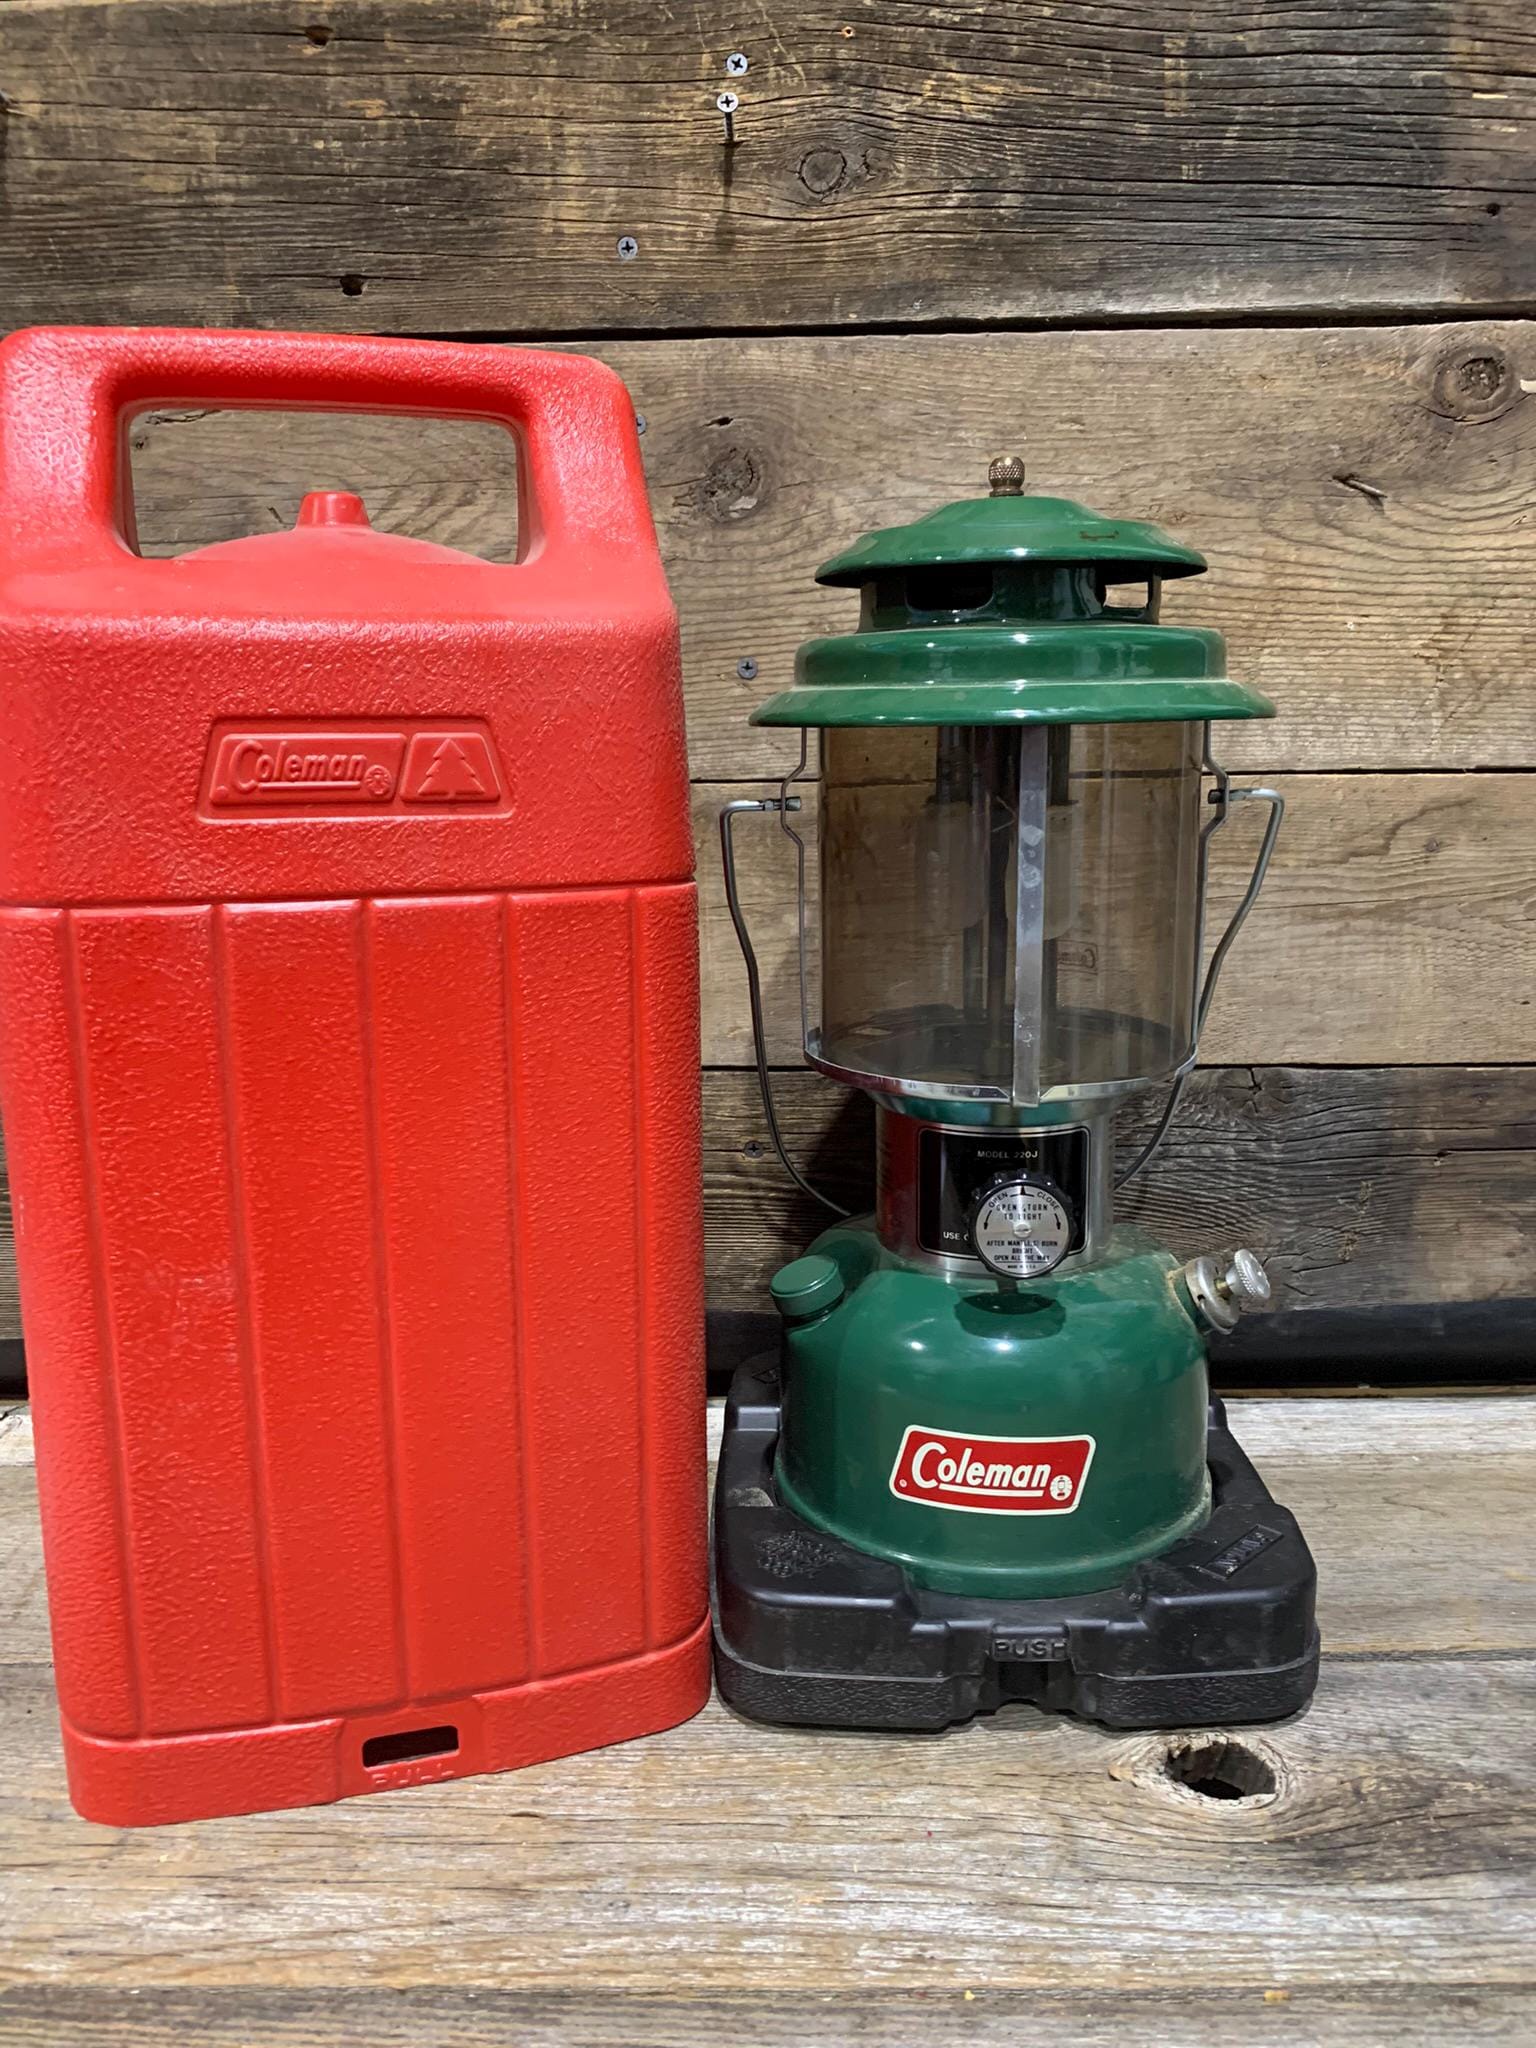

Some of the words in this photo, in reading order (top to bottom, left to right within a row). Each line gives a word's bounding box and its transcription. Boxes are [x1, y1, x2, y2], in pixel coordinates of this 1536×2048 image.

[228, 738, 368, 793] Coleman
[977, 1150, 1010, 1159] MODEL
[1027, 1203, 1048, 1212] TURN
[1036, 1191, 1061, 1211] CLOSE
[943, 1231, 961, 1242] USE
[911, 1441, 1052, 1490] Coleman
[994, 1638, 1069, 1659] PUSH
[371, 1762, 456, 1787] PULL
